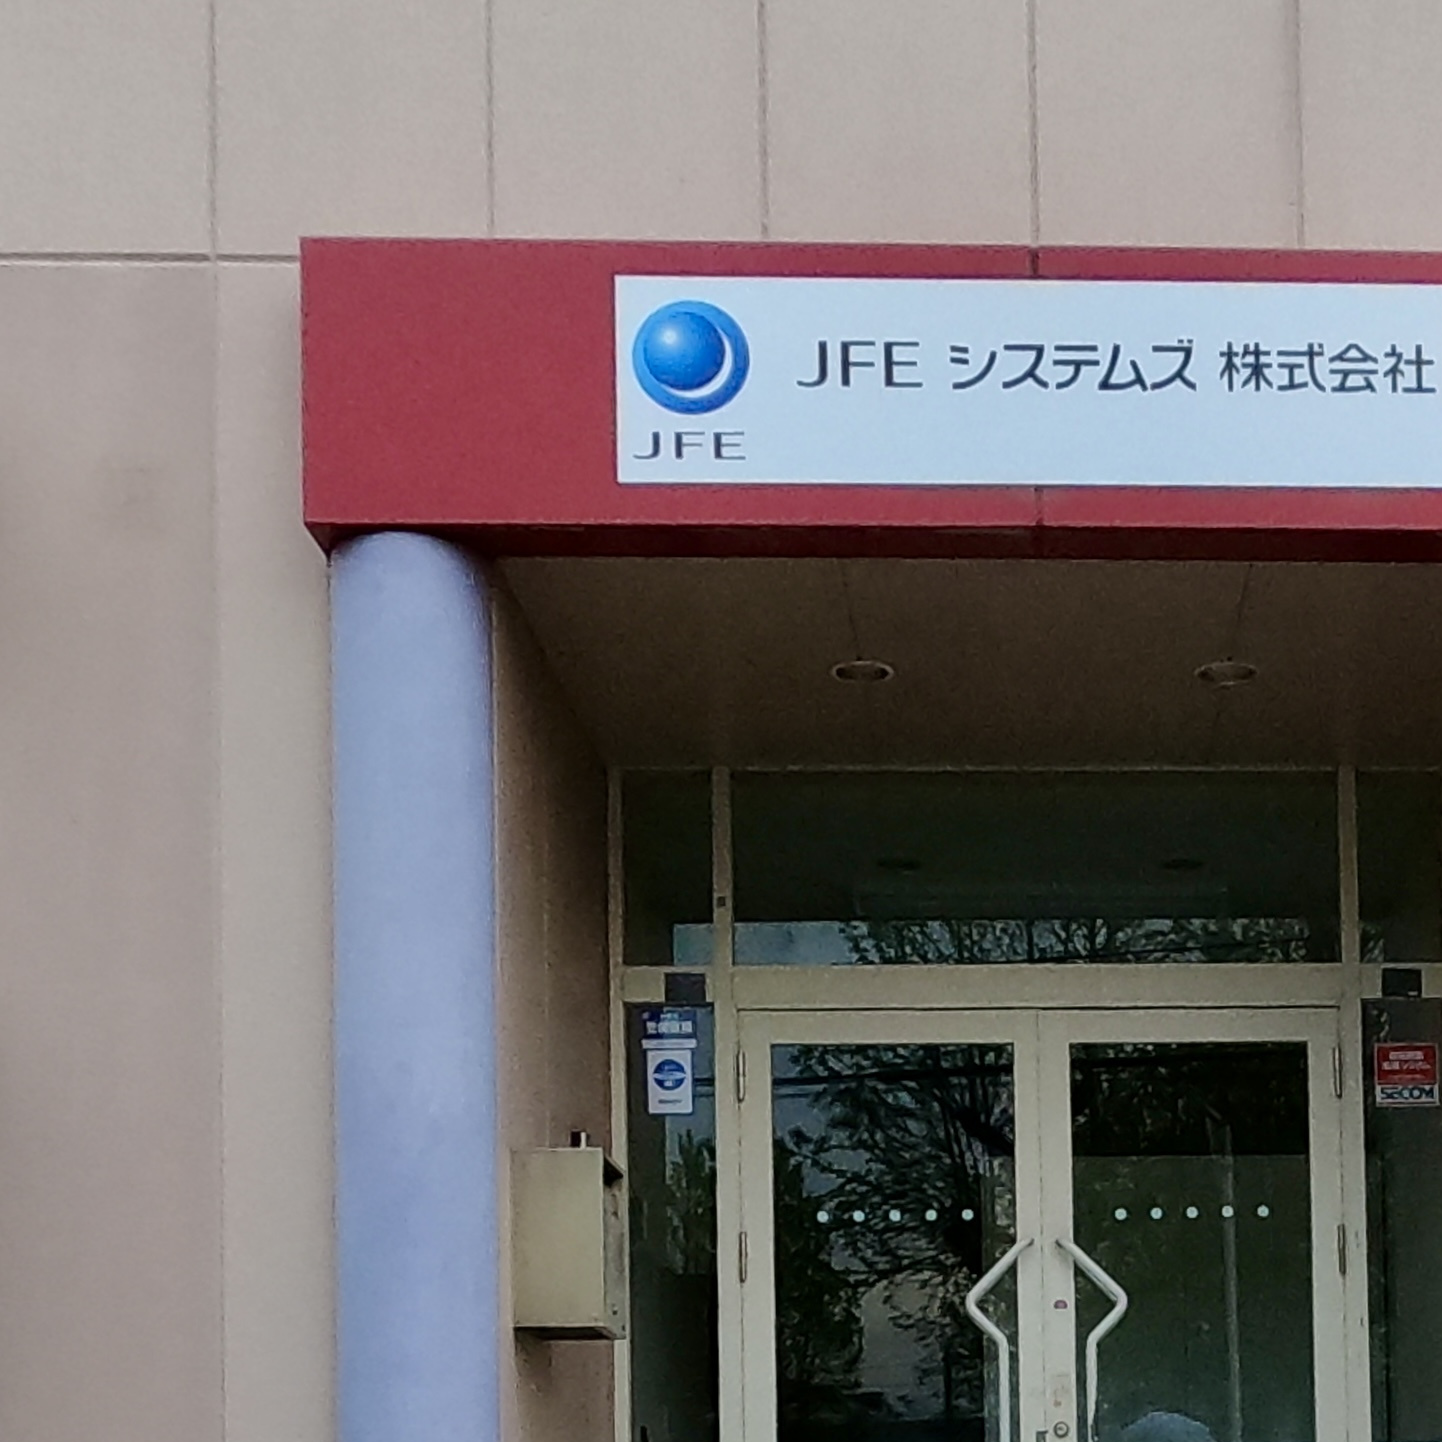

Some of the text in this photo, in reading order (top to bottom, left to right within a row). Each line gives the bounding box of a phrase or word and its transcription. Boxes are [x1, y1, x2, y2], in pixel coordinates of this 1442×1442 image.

[796, 338, 1438, 396] JFE システムズ 株式会社
[632, 429, 748, 462] JFE
